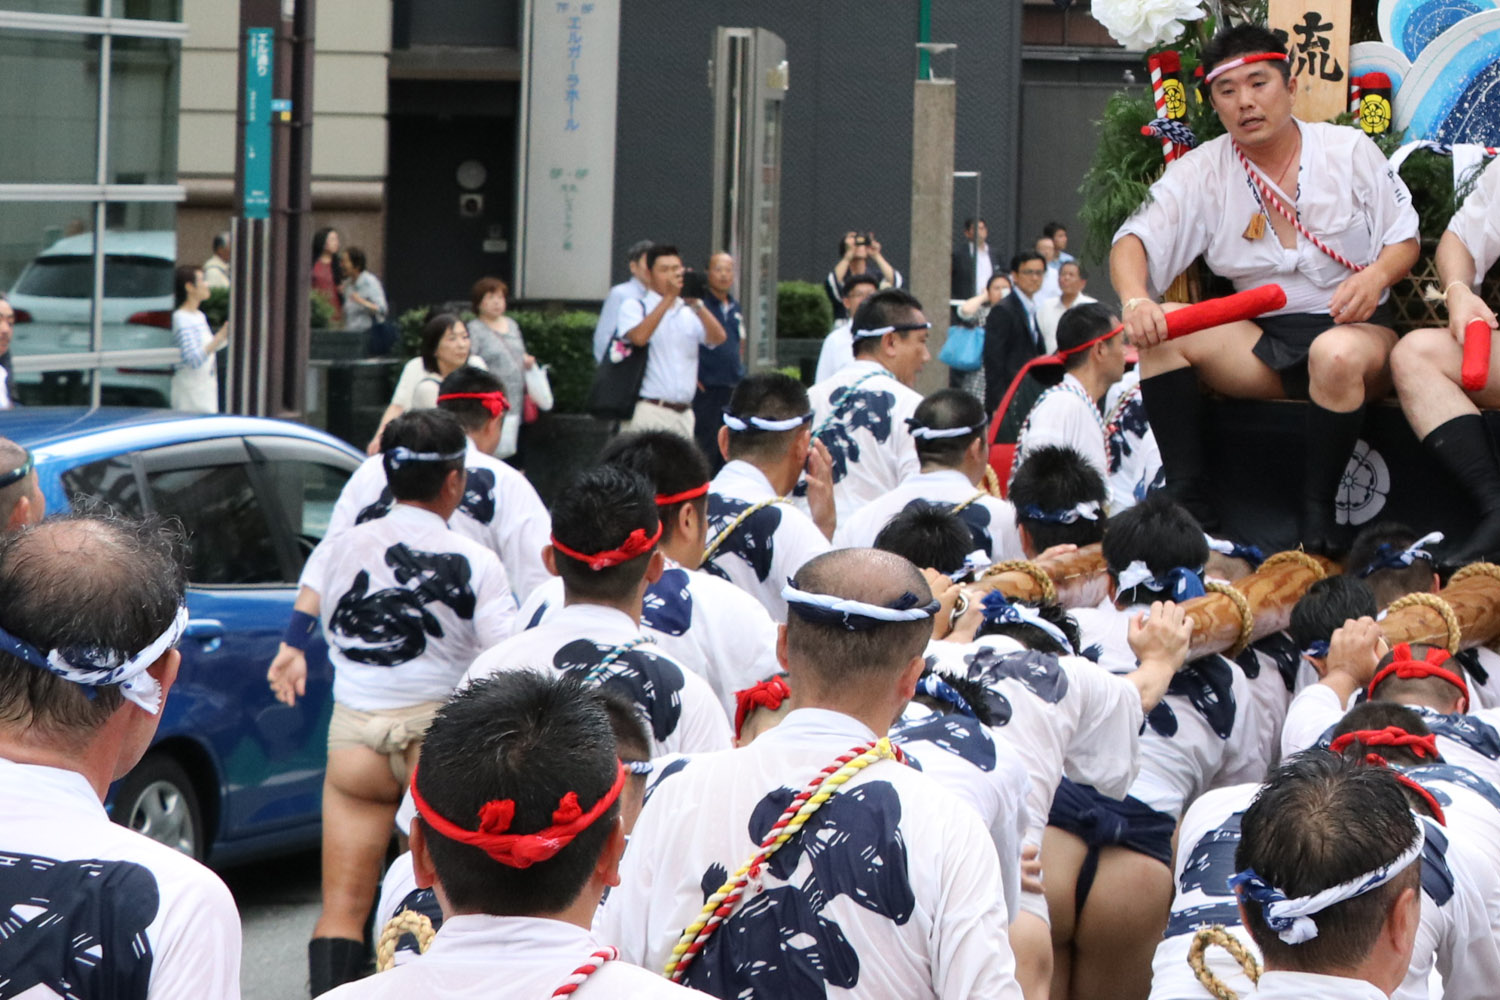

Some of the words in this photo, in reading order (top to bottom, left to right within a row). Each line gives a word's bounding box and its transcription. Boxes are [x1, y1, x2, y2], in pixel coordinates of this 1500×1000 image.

[564, 16, 583, 132] エルガーラホール
